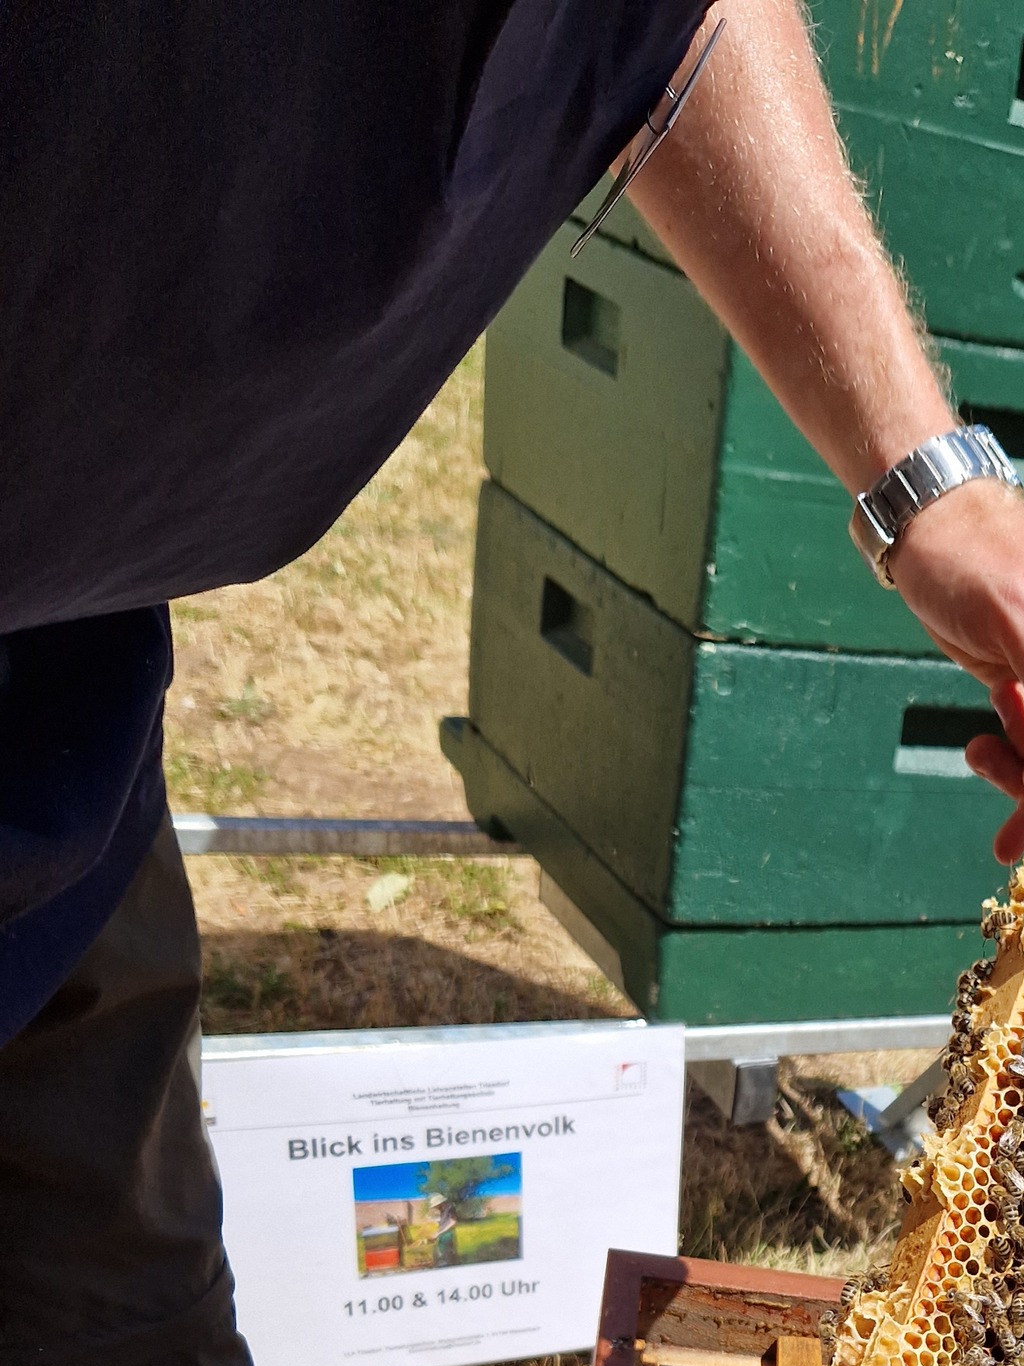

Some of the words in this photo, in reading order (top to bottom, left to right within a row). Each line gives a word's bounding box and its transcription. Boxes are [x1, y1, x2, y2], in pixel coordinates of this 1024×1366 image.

[288, 1135, 363, 1161] Blick
[374, 1133, 415, 1154] ins
[426, 1116, 577, 1148] Bienenvolk
[344, 1295, 404, 1317] 11.00
[412, 1292, 428, 1308] &
[437, 1284, 494, 1304] 14.00
[501, 1279, 541, 1296] Uhr
